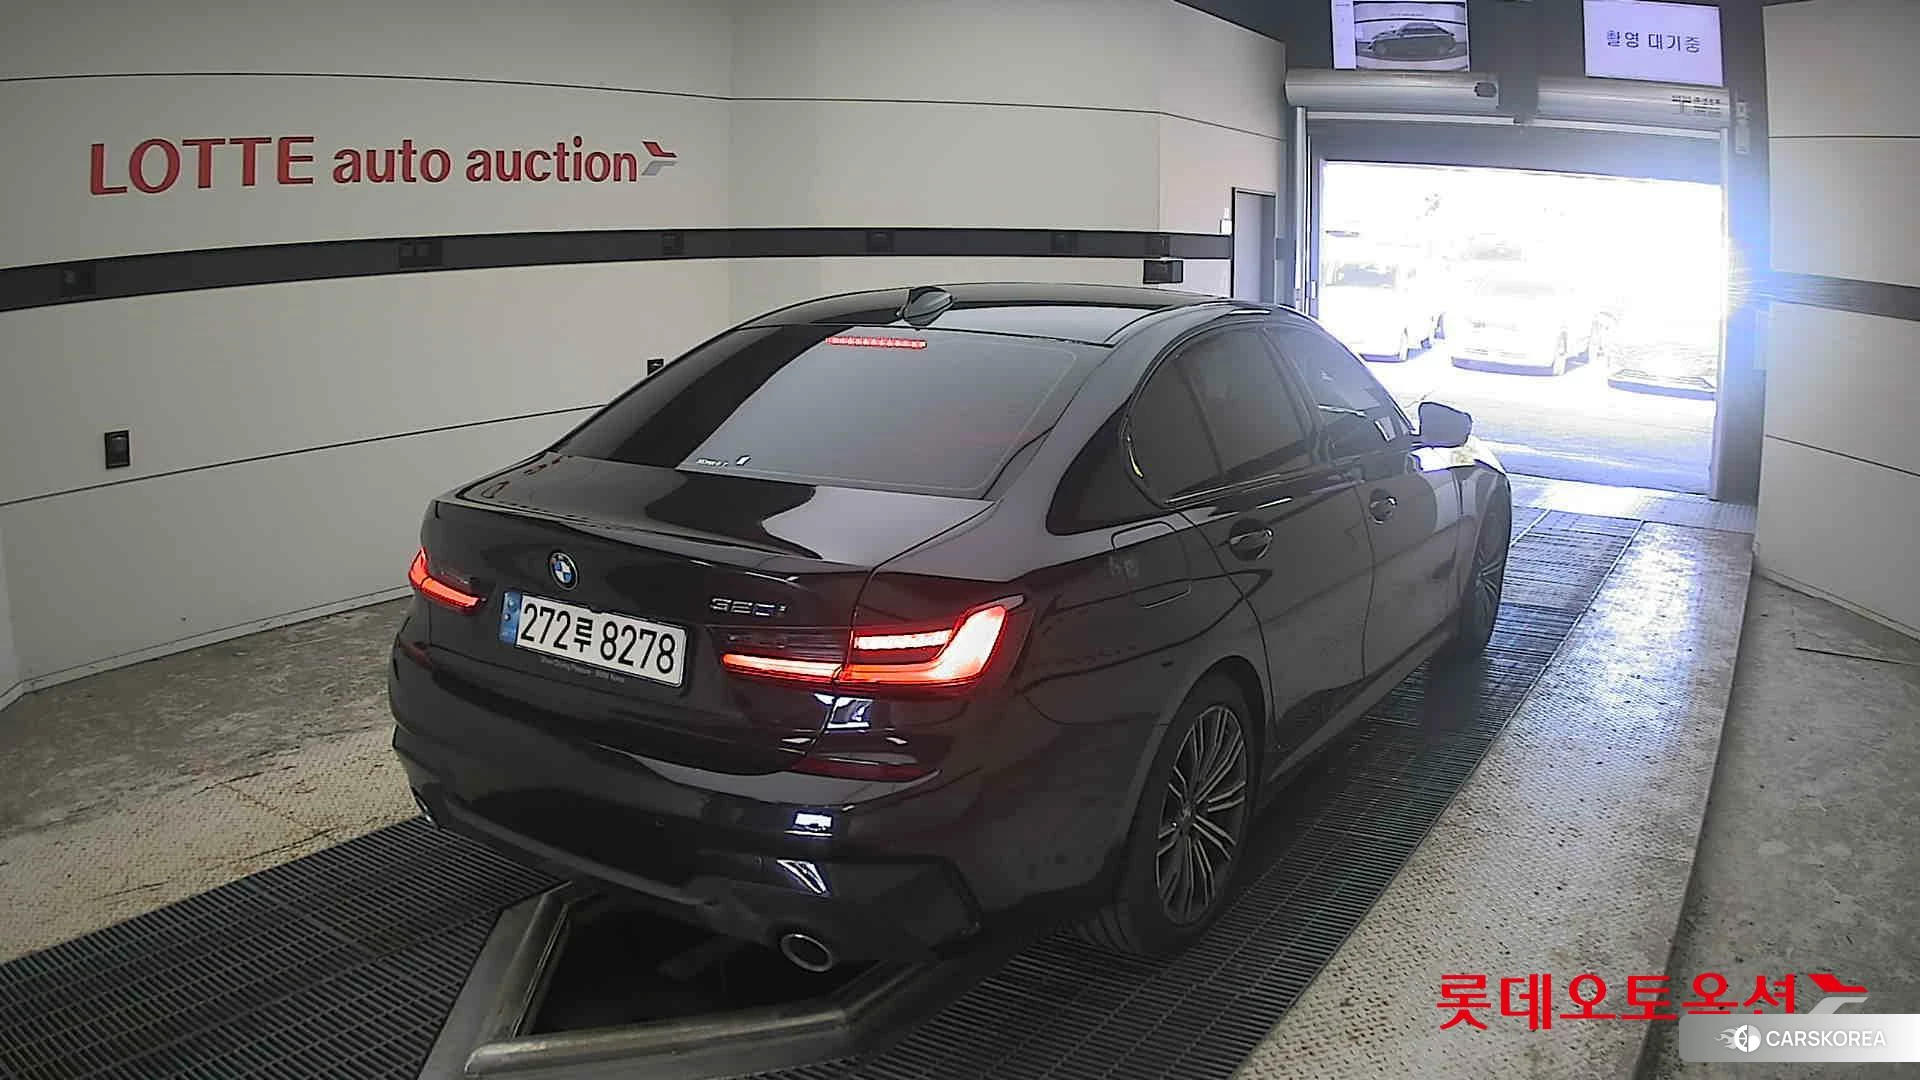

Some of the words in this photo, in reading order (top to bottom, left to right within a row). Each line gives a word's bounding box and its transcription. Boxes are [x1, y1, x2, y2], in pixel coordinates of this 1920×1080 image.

[90, 136, 314, 195] LOTTE
[333, 139, 451, 183] auto
[465, 135, 637, 182] auction
